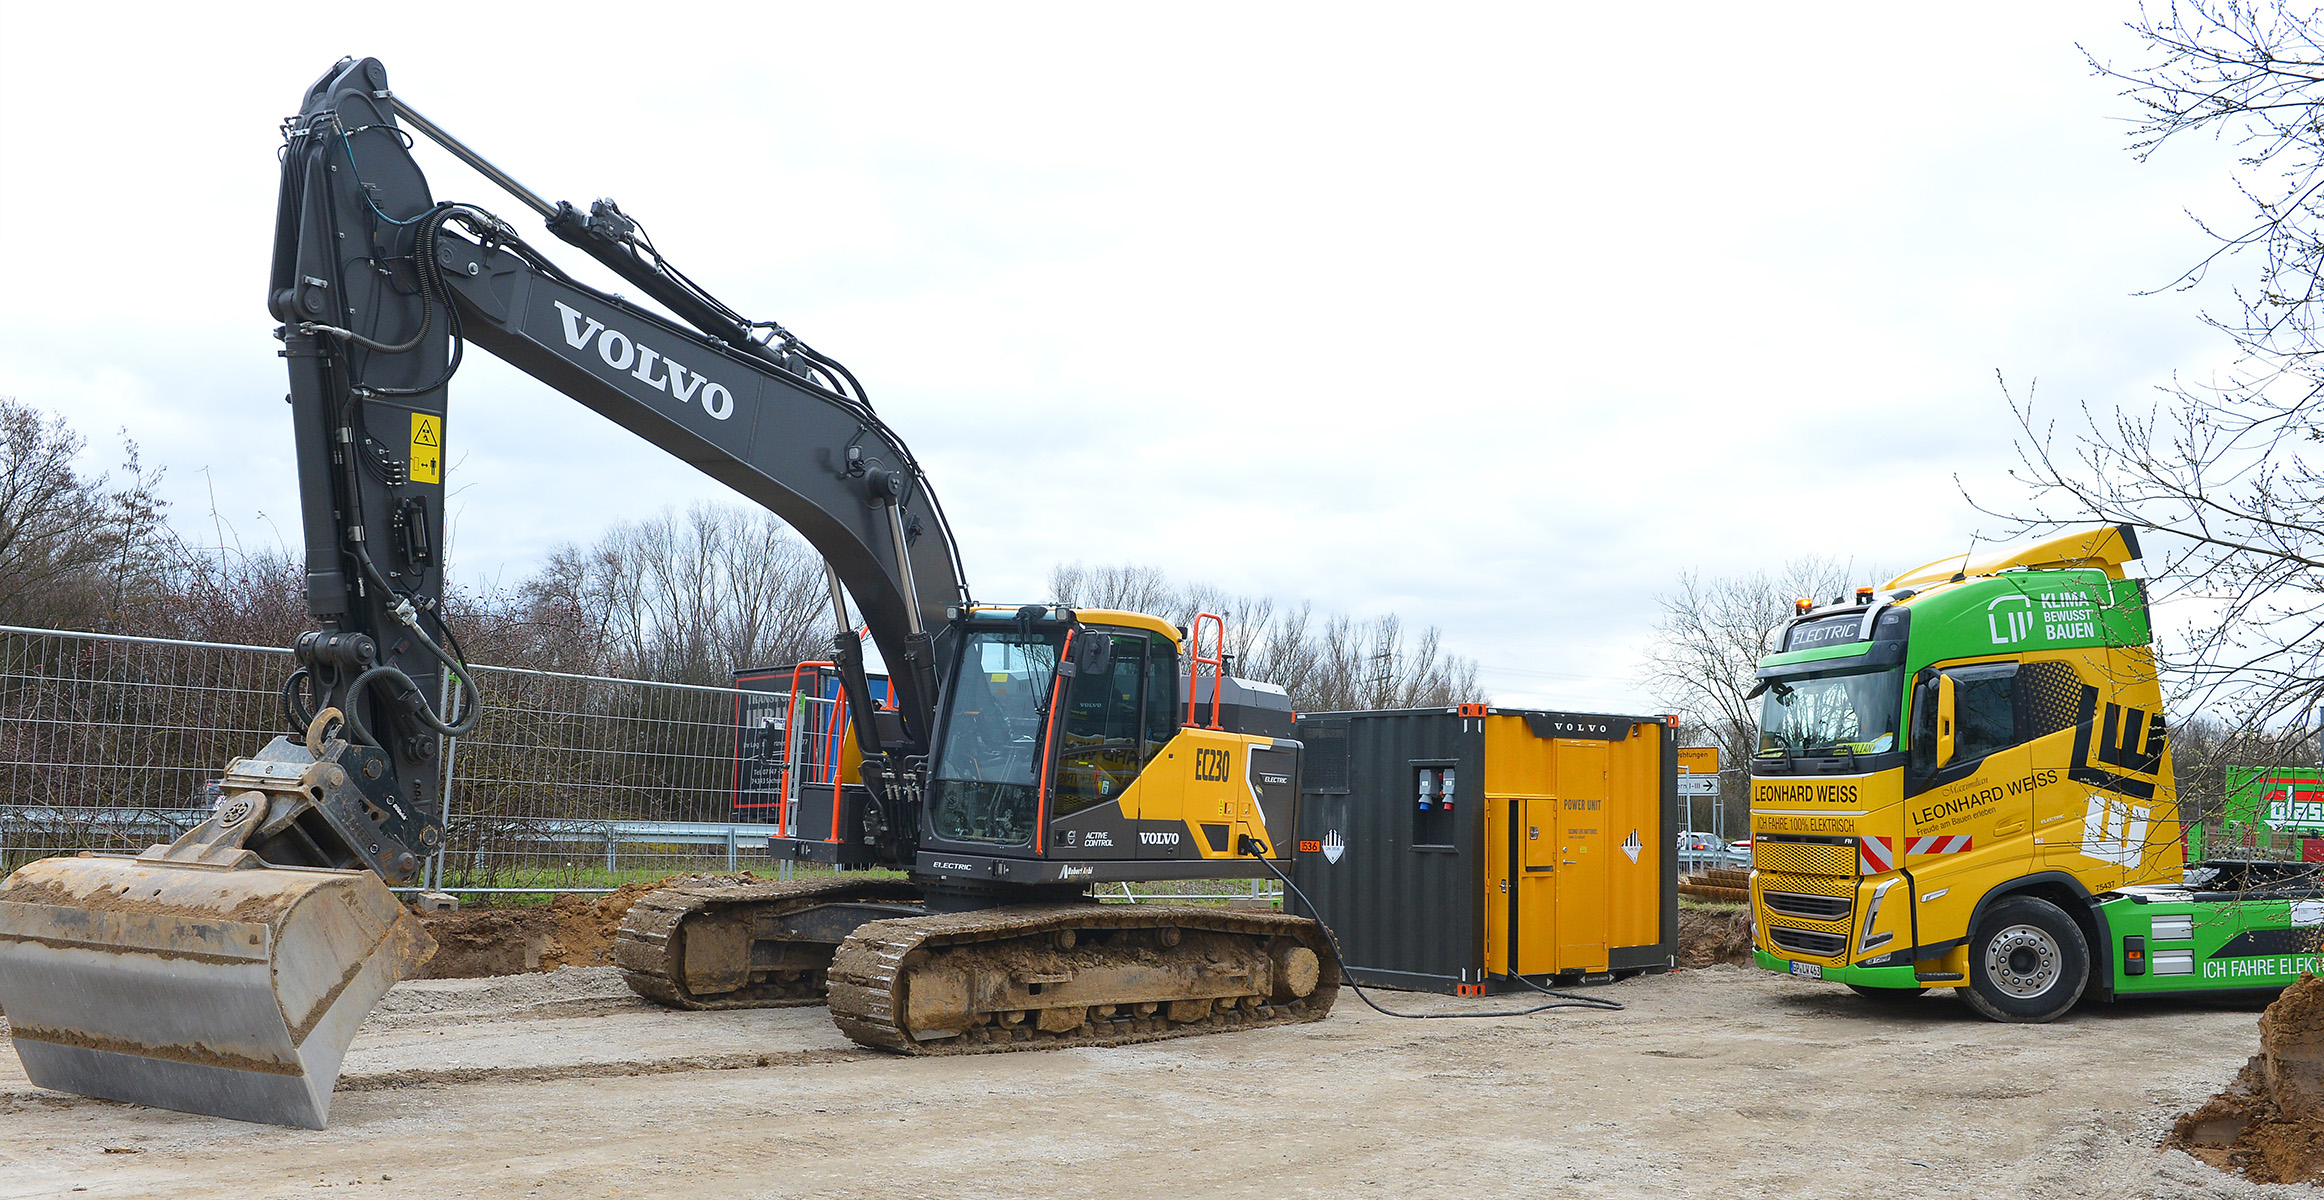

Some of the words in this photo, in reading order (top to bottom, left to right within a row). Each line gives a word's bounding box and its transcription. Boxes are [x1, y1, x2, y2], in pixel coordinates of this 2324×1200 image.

[553, 300, 734, 421] VOLVO
[2040, 591, 2090, 609] KLIMA
[2043, 609, 2091, 623] BEWUSST
[1792, 623, 1857, 645] ELECTRIC
[2045, 622, 2095, 640] BAUEN
[1554, 722, 1607, 733] VOLVO
[1679, 751, 1709, 759] chtungen
[1195, 747, 1230, 783] EC230
[1264, 776, 1288, 784] ELECTRIC
[1755, 785, 1813, 803] LEONHARD
[1816, 785, 1858, 803] WEISS
[1912, 786, 2004, 825] LEONHARD
[2006, 769, 2058, 796] WEISS
[1564, 799, 1586, 811] POWER
[1587, 799, 1602, 811] UNIT
[1757, 816, 1767, 829] ICH
[1768, 817, 1788, 830] FAHRE
[1789, 818, 1809, 831] 100%
[1810, 818, 1855, 832] ELEKTRISCH
[1916, 822, 1940, 836] Freude
[1940, 820, 1951, 829] am
[1952, 814, 1973, 827] Bauen
[1973, 806, 1997, 820] erleben
[2040, 813, 2065, 825] ELECTRIC
[1084, 838, 1114, 847] CONTROL
[1085, 831, 1109, 840] ACTIVE
[1139, 832, 1180, 846] VOLVO
[933, 861, 972, 871] ELECTRIC
[2095, 880, 2115, 892] 75437
[2203, 961, 2227, 978] ICH
[2231, 959, 2276, 977] FAHRE
